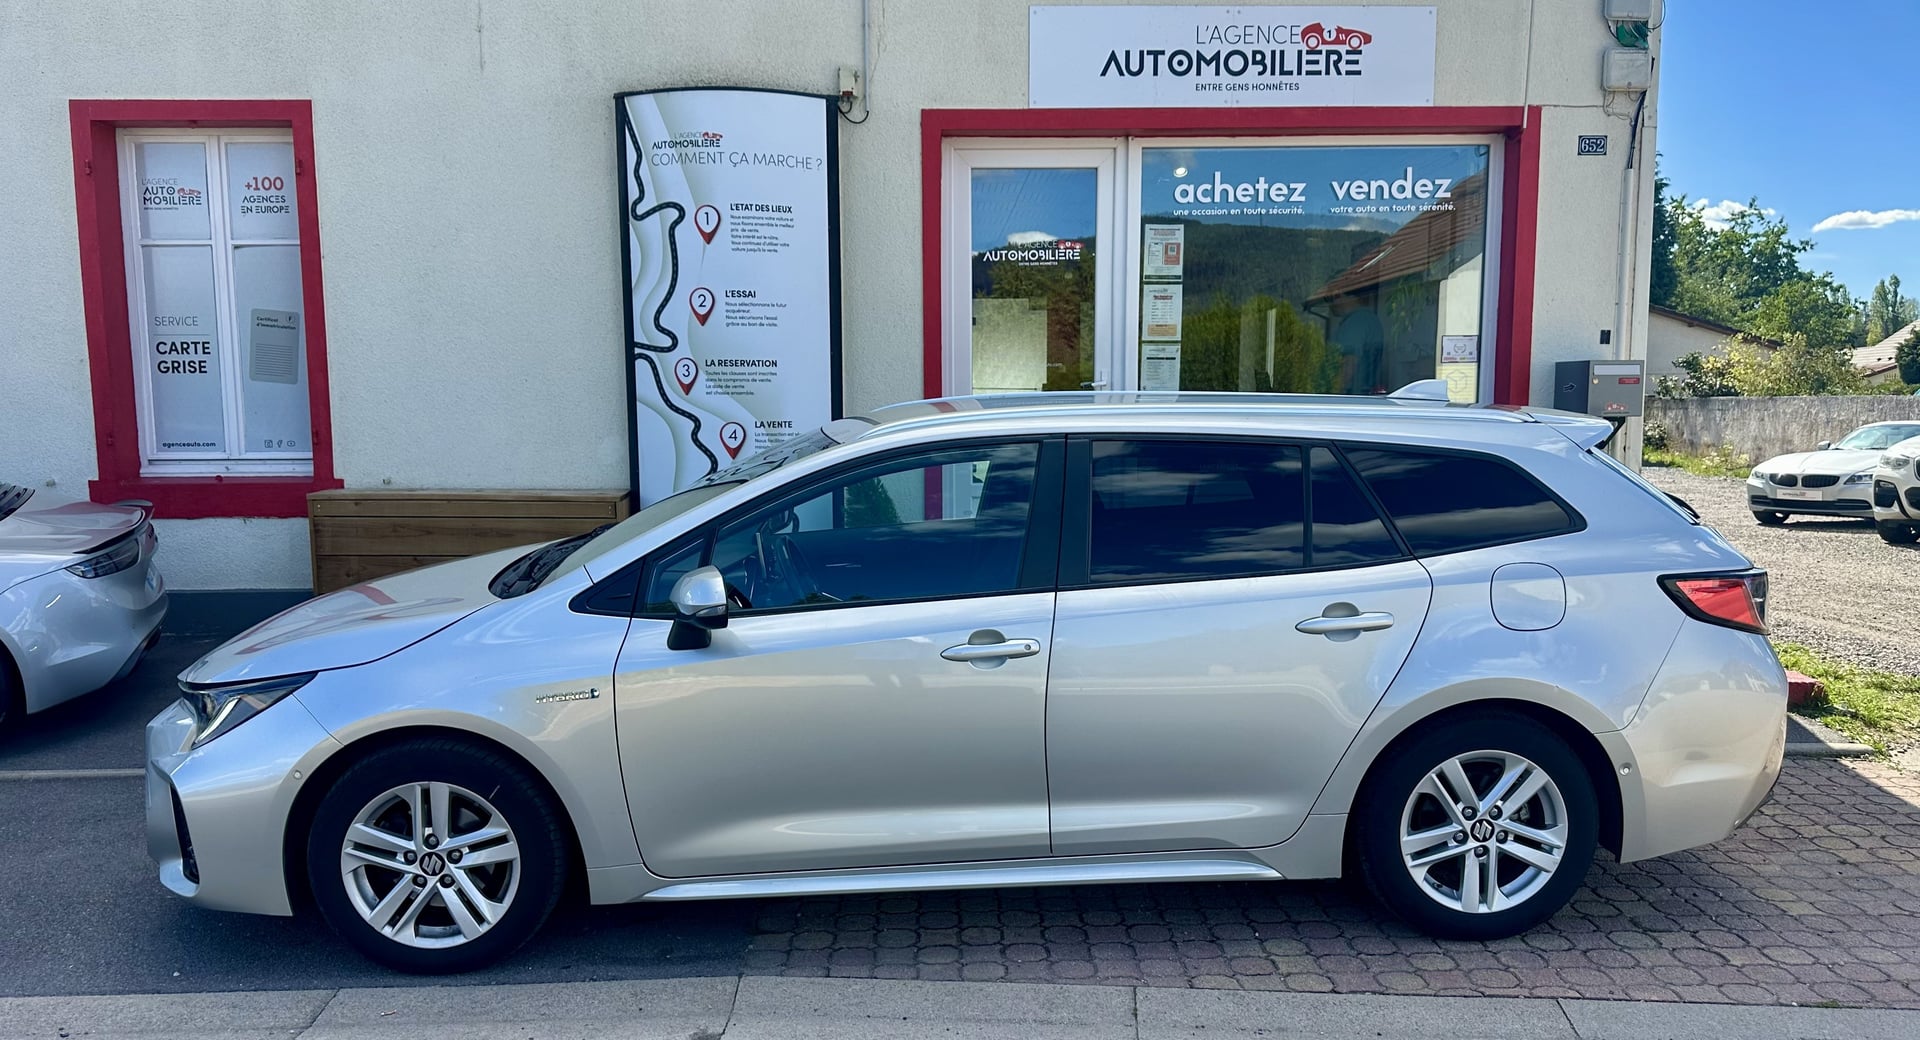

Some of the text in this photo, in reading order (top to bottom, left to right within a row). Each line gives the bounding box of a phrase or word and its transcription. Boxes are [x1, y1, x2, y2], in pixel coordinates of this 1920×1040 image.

[1196, 24, 1301, 45] L'AGENCE
[1195, 80, 1300, 92] ENTRE GENS HONNÊTES
[1580, 138, 1605, 152] 652
[651, 152, 823, 170] COMMENT ÇA MARCHE ?
[245, 176, 284, 191] +100
[1174, 171, 1307, 204] achetez
[1331, 167, 1452, 200] vendez
[143, 186, 176, 196] AUTO
[242, 195, 286, 203] AGENCES
[241, 205, 290, 214] EN EUROPE
[730, 203, 793, 214] L'ETAT DES LIEUX
[1191, 207, 1228, 216] occasion
[1243, 207, 1267, 215] toute
[1268, 206, 1305, 215] sécurité.
[1355, 205, 1376, 213] auto
[1392, 203, 1417, 212] toute
[1418, 202, 1457, 212] sérénité.
[704, 211, 710, 226] 1
[725, 289, 756, 299] L'ESSAI
[697, 294, 707, 307] 2
[154, 316, 199, 327] SERVICE
[155, 341, 212, 355] CARTE
[157, 360, 208, 374] GRISE
[705, 359, 778, 368] LA RESERVATION
[682, 364, 690, 378] 3
[754, 420, 793, 429] LA VENTE
[728, 429, 738, 441] 4
[162, 440, 216, 449] agenceauto.com
